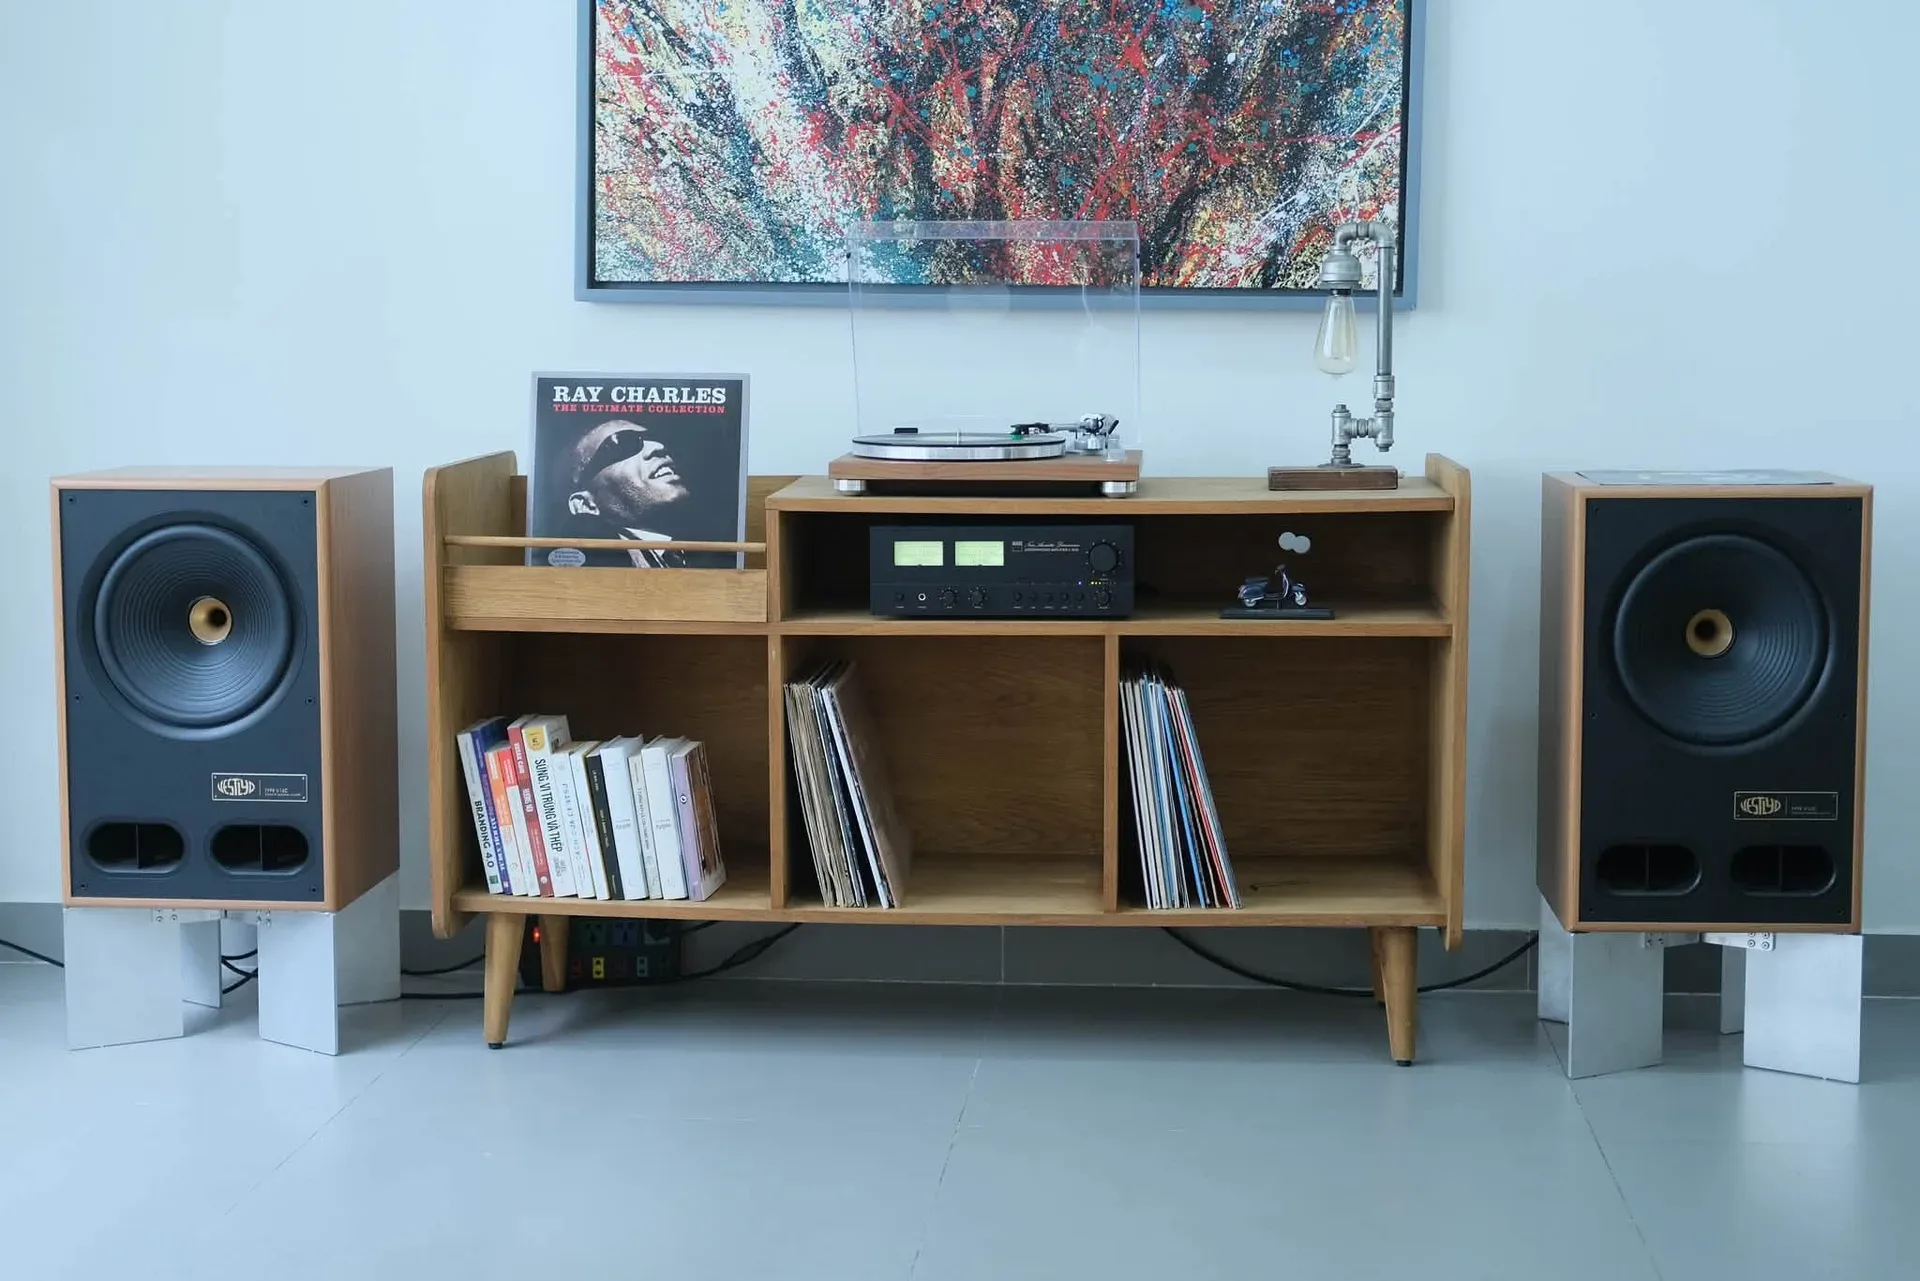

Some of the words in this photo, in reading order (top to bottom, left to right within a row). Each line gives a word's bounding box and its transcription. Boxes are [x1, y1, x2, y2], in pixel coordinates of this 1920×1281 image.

[553, 386, 603, 402] RAY
[611, 386, 726, 404] CHARLES
[553, 404, 577, 412] THE
[582, 404, 643, 413] ULTIMATE
[648, 405, 725, 414] COLLECTION
[474, 800, 490, 848] BRANDING
[486, 852, 494, 868] 4.0
